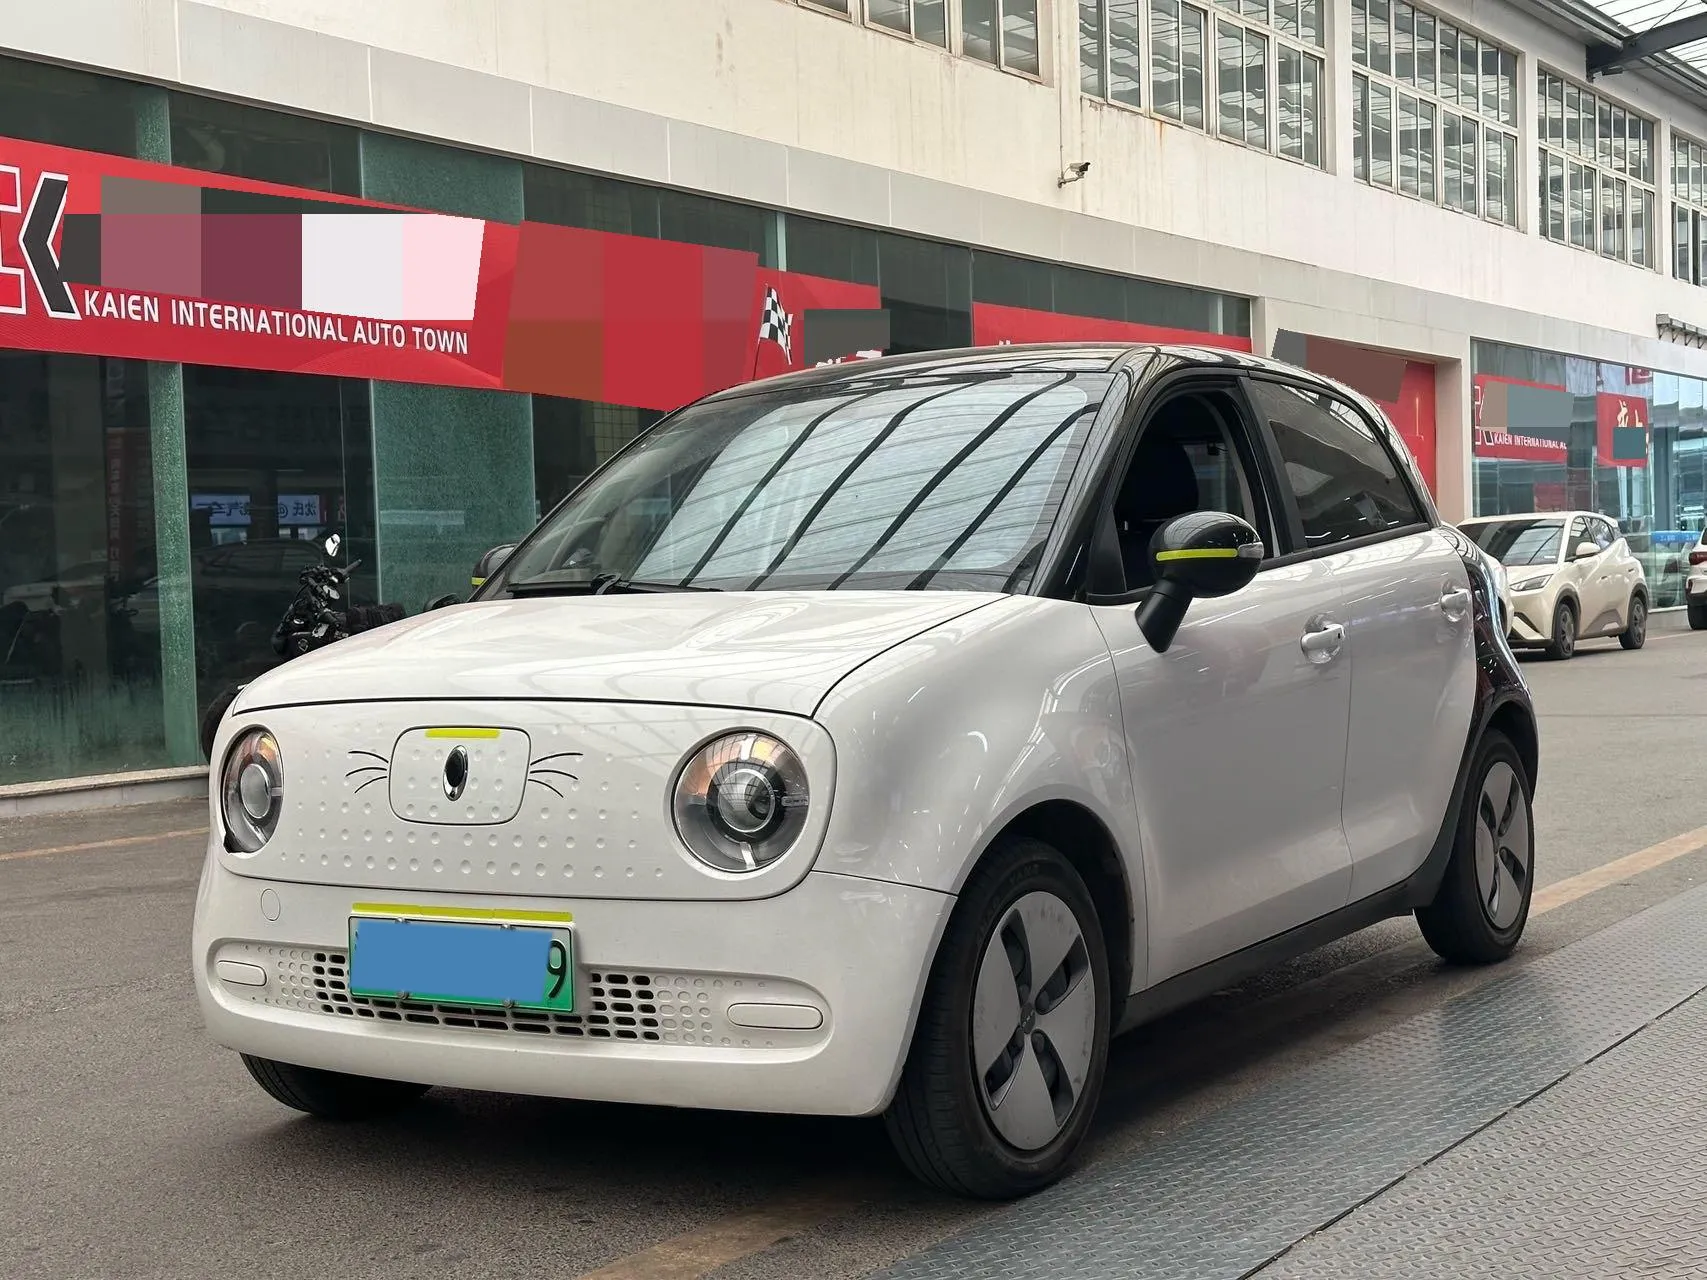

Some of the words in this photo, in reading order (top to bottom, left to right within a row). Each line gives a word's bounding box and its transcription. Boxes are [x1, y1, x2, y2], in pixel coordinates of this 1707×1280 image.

[84, 289, 159, 323] KAIEN
[171, 298, 348, 342] INTERNATIONAL
[353, 320, 406, 348] AUTO
[411, 326, 468, 355] TOWN
